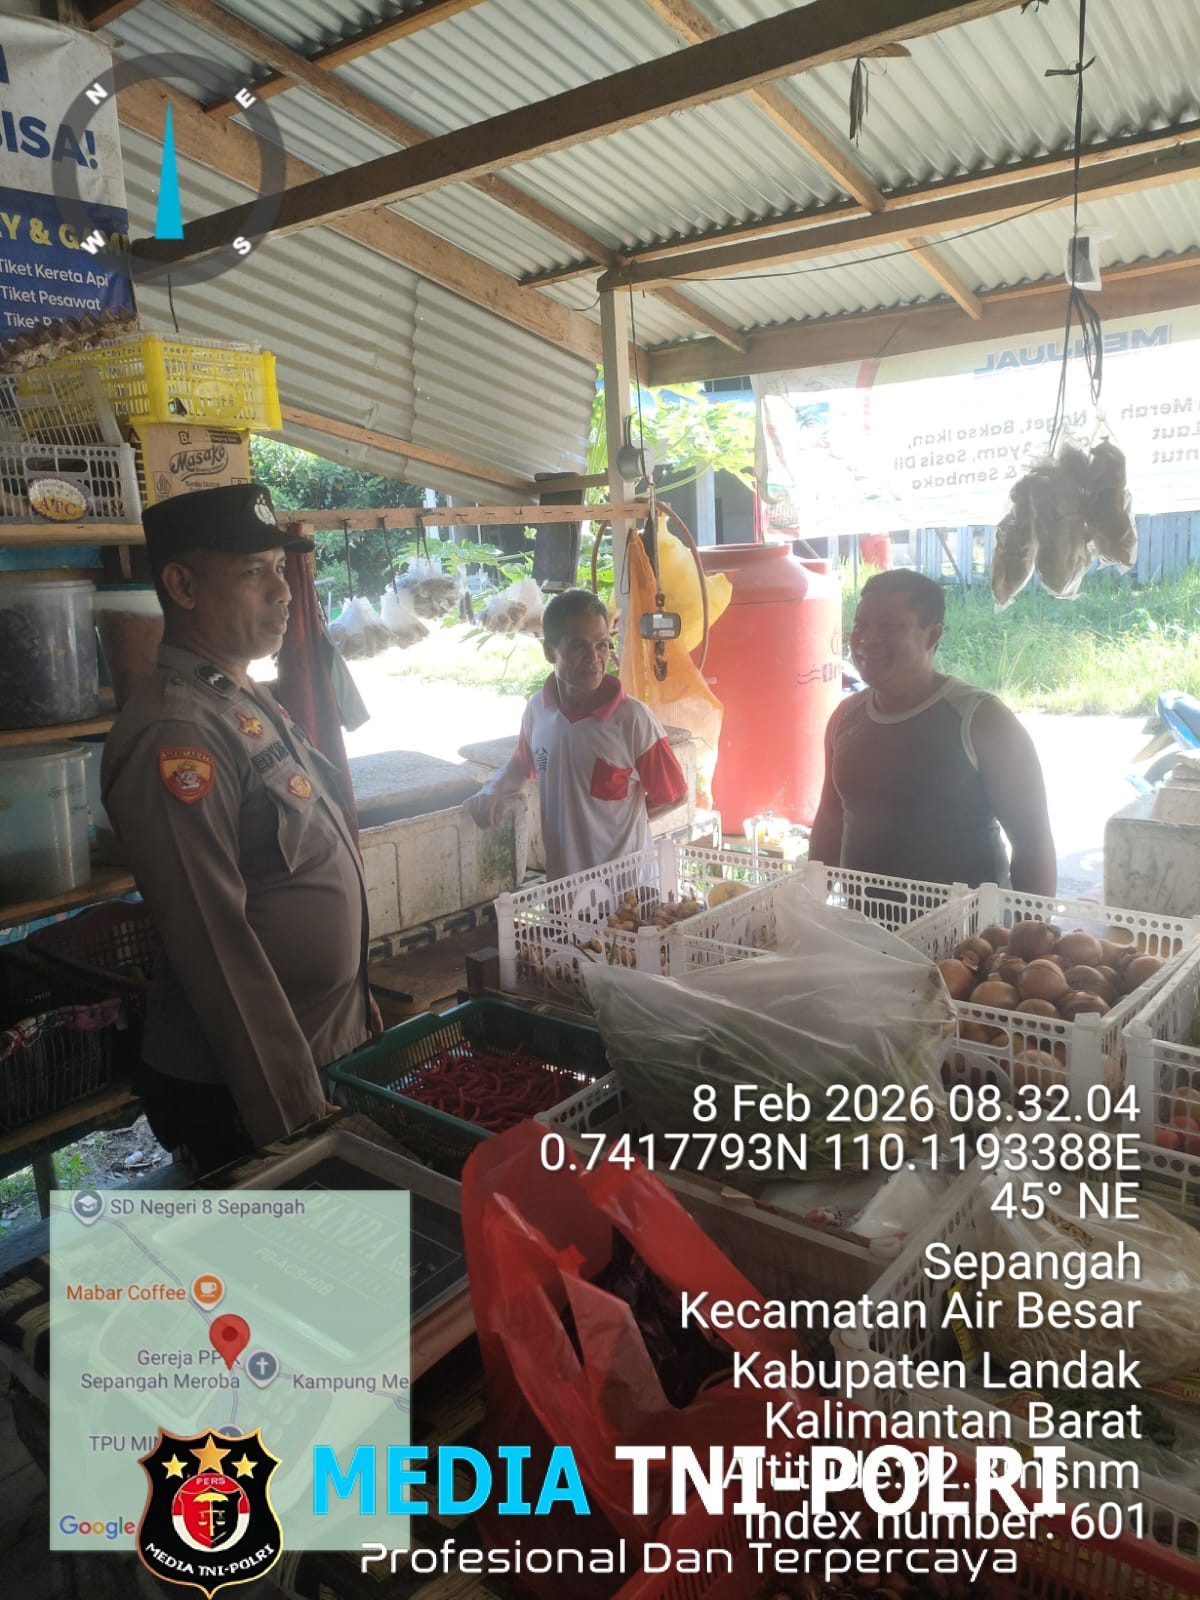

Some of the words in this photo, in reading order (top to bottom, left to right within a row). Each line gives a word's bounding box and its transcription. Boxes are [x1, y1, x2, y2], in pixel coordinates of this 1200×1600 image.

[0, 111, 98, 170] ISA!
[29, 218, 53, 247] &
[0, 258, 33, 277] Tiket
[35, 263, 84, 284] Kereta
[86, 271, 110, 288] Api
[0, 285, 37, 304] Tiket
[39, 291, 102, 311] Pesawat
[169, 444, 226, 474] Masako
